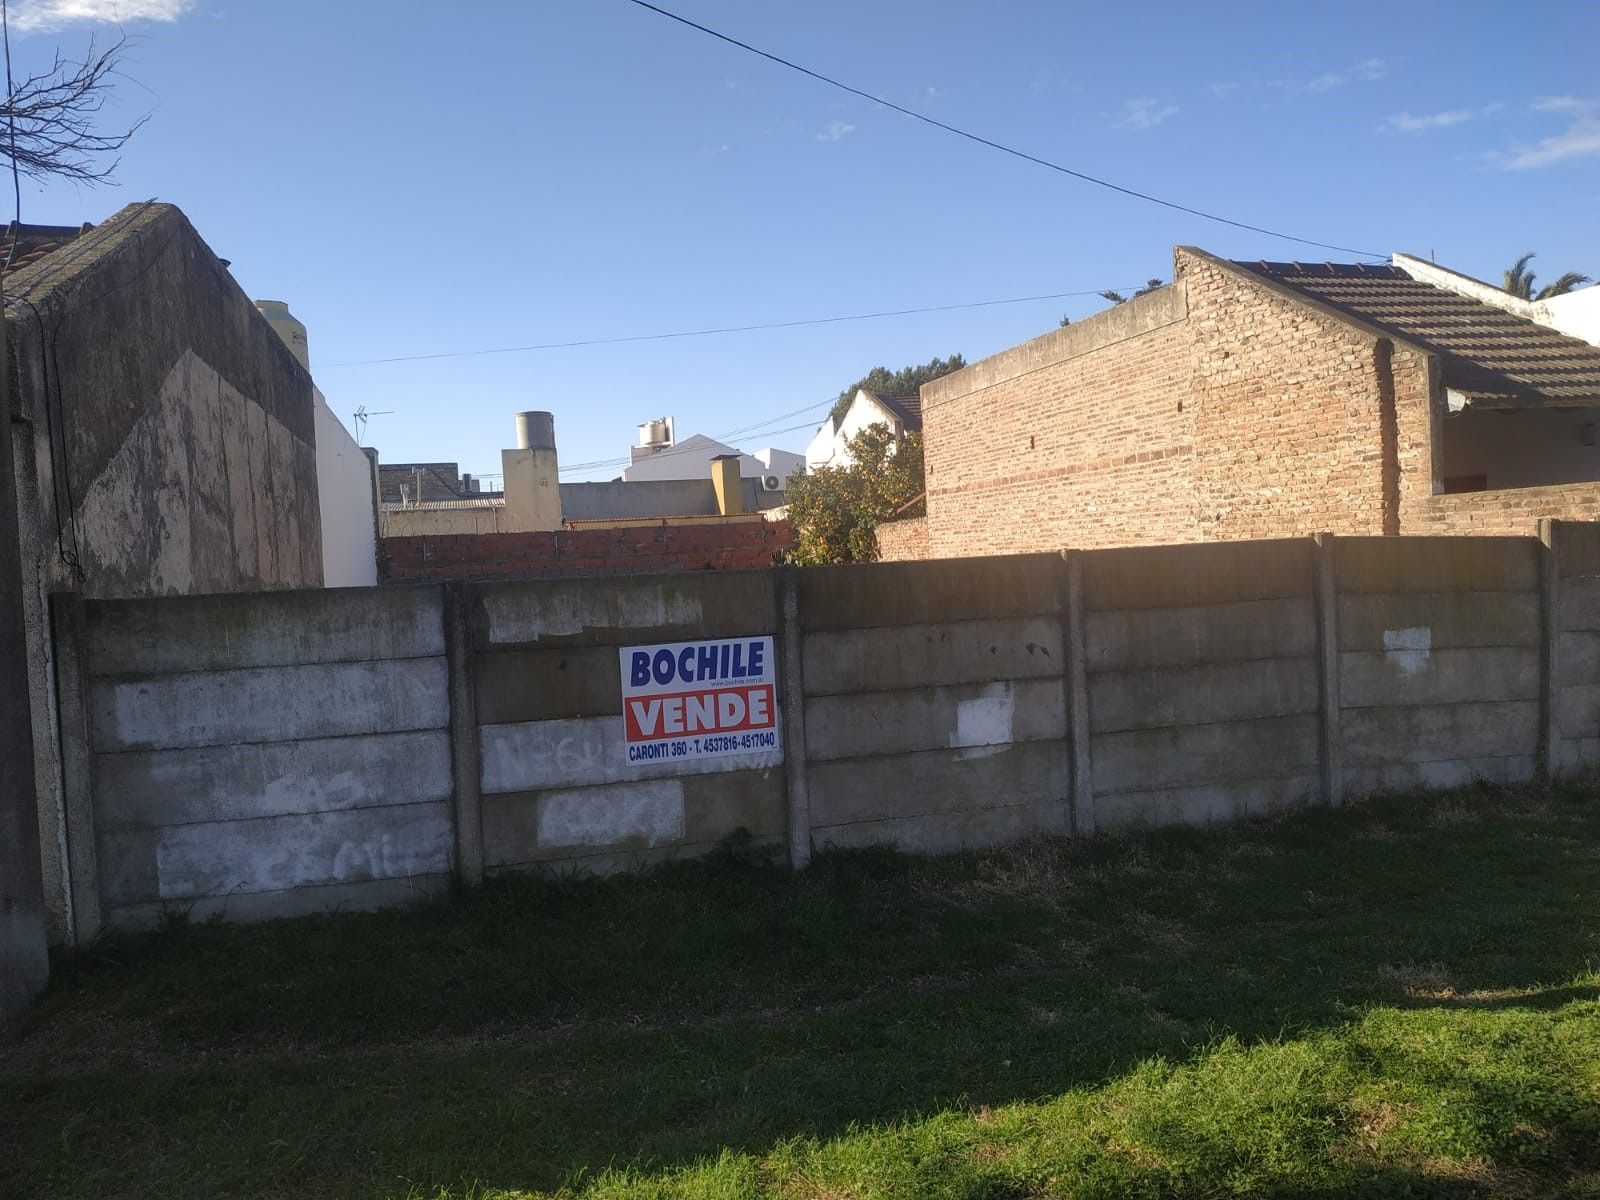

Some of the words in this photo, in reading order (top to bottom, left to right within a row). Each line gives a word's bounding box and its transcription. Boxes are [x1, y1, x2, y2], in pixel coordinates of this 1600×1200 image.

[631, 641, 765, 687] BOCHILE
[630, 689, 769, 736] VENDE
[629, 742, 669, 762] CARONTI
[671, 740, 687, 757] 360
[694, 739, 702, 754] T.
